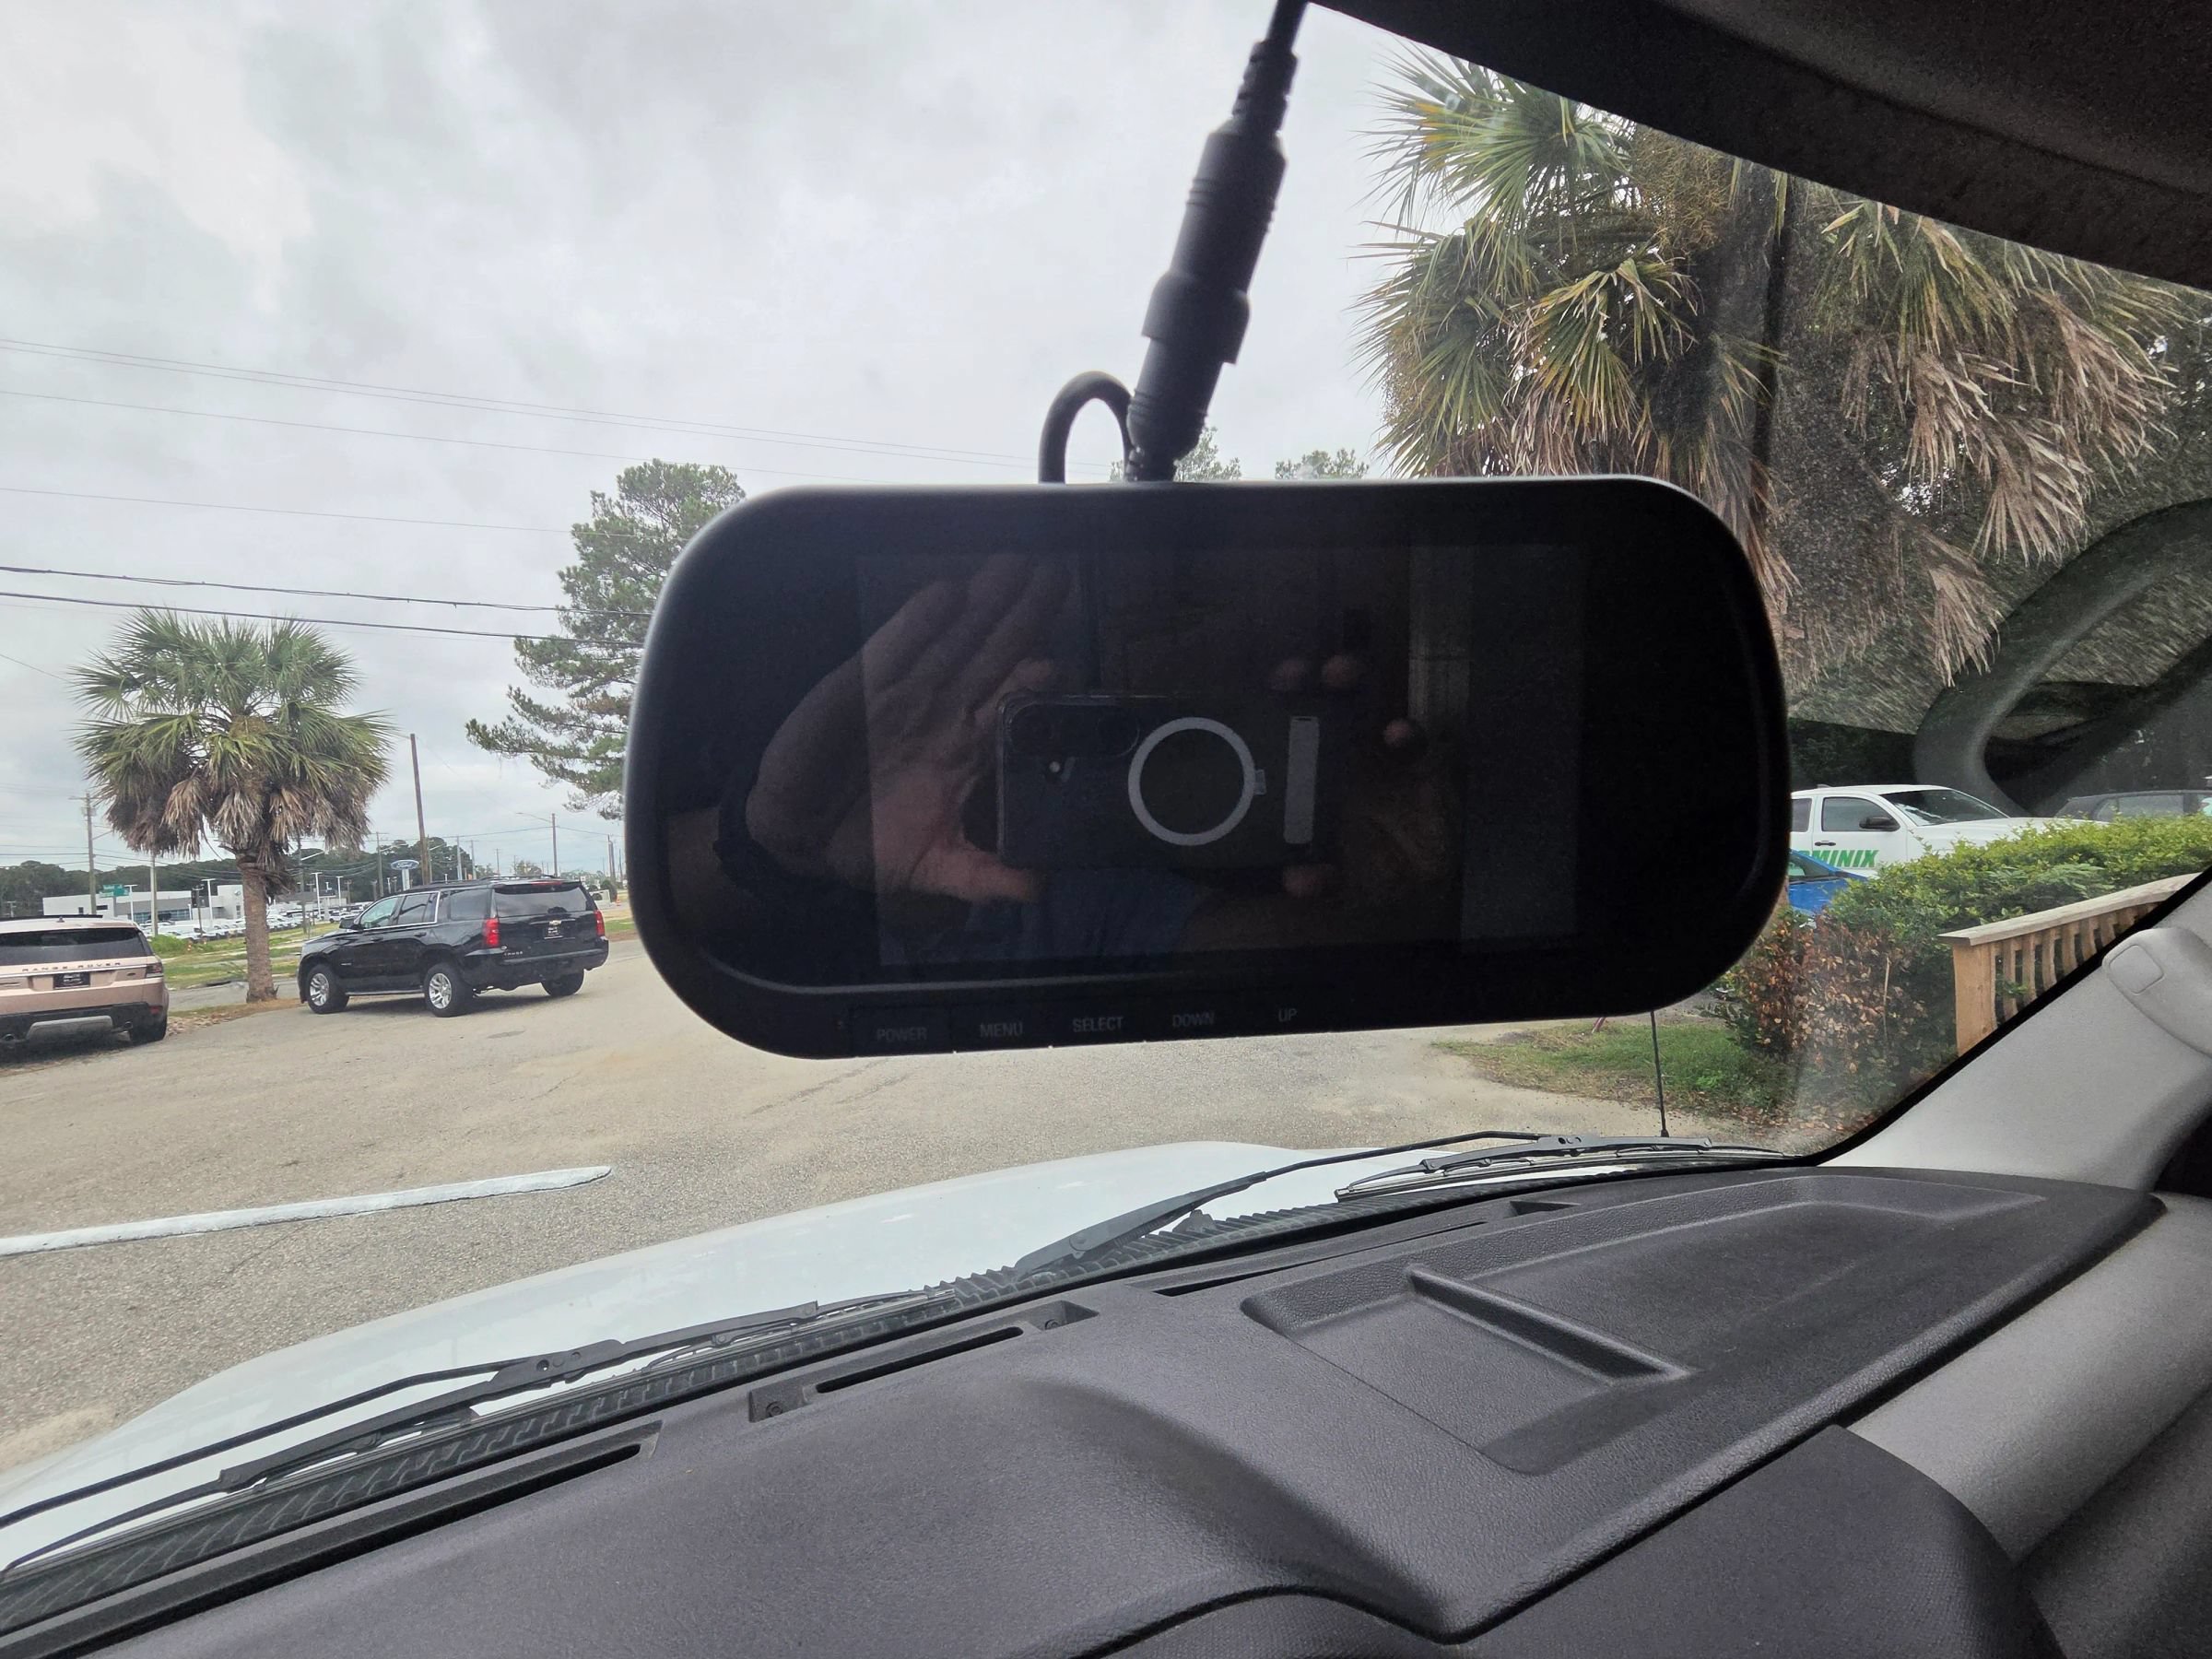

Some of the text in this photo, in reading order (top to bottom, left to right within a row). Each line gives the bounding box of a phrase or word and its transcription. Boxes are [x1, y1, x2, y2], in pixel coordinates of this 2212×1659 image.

[1798, 850, 1879, 868] MINIX
[1171, 1012, 1216, 1029] DOWN
[1277, 1007, 1298, 1023] UP
[979, 1021, 1024, 1038] MENU
[1072, 1016, 1124, 1032] SELECT
[877, 1027, 928, 1043] POWER
